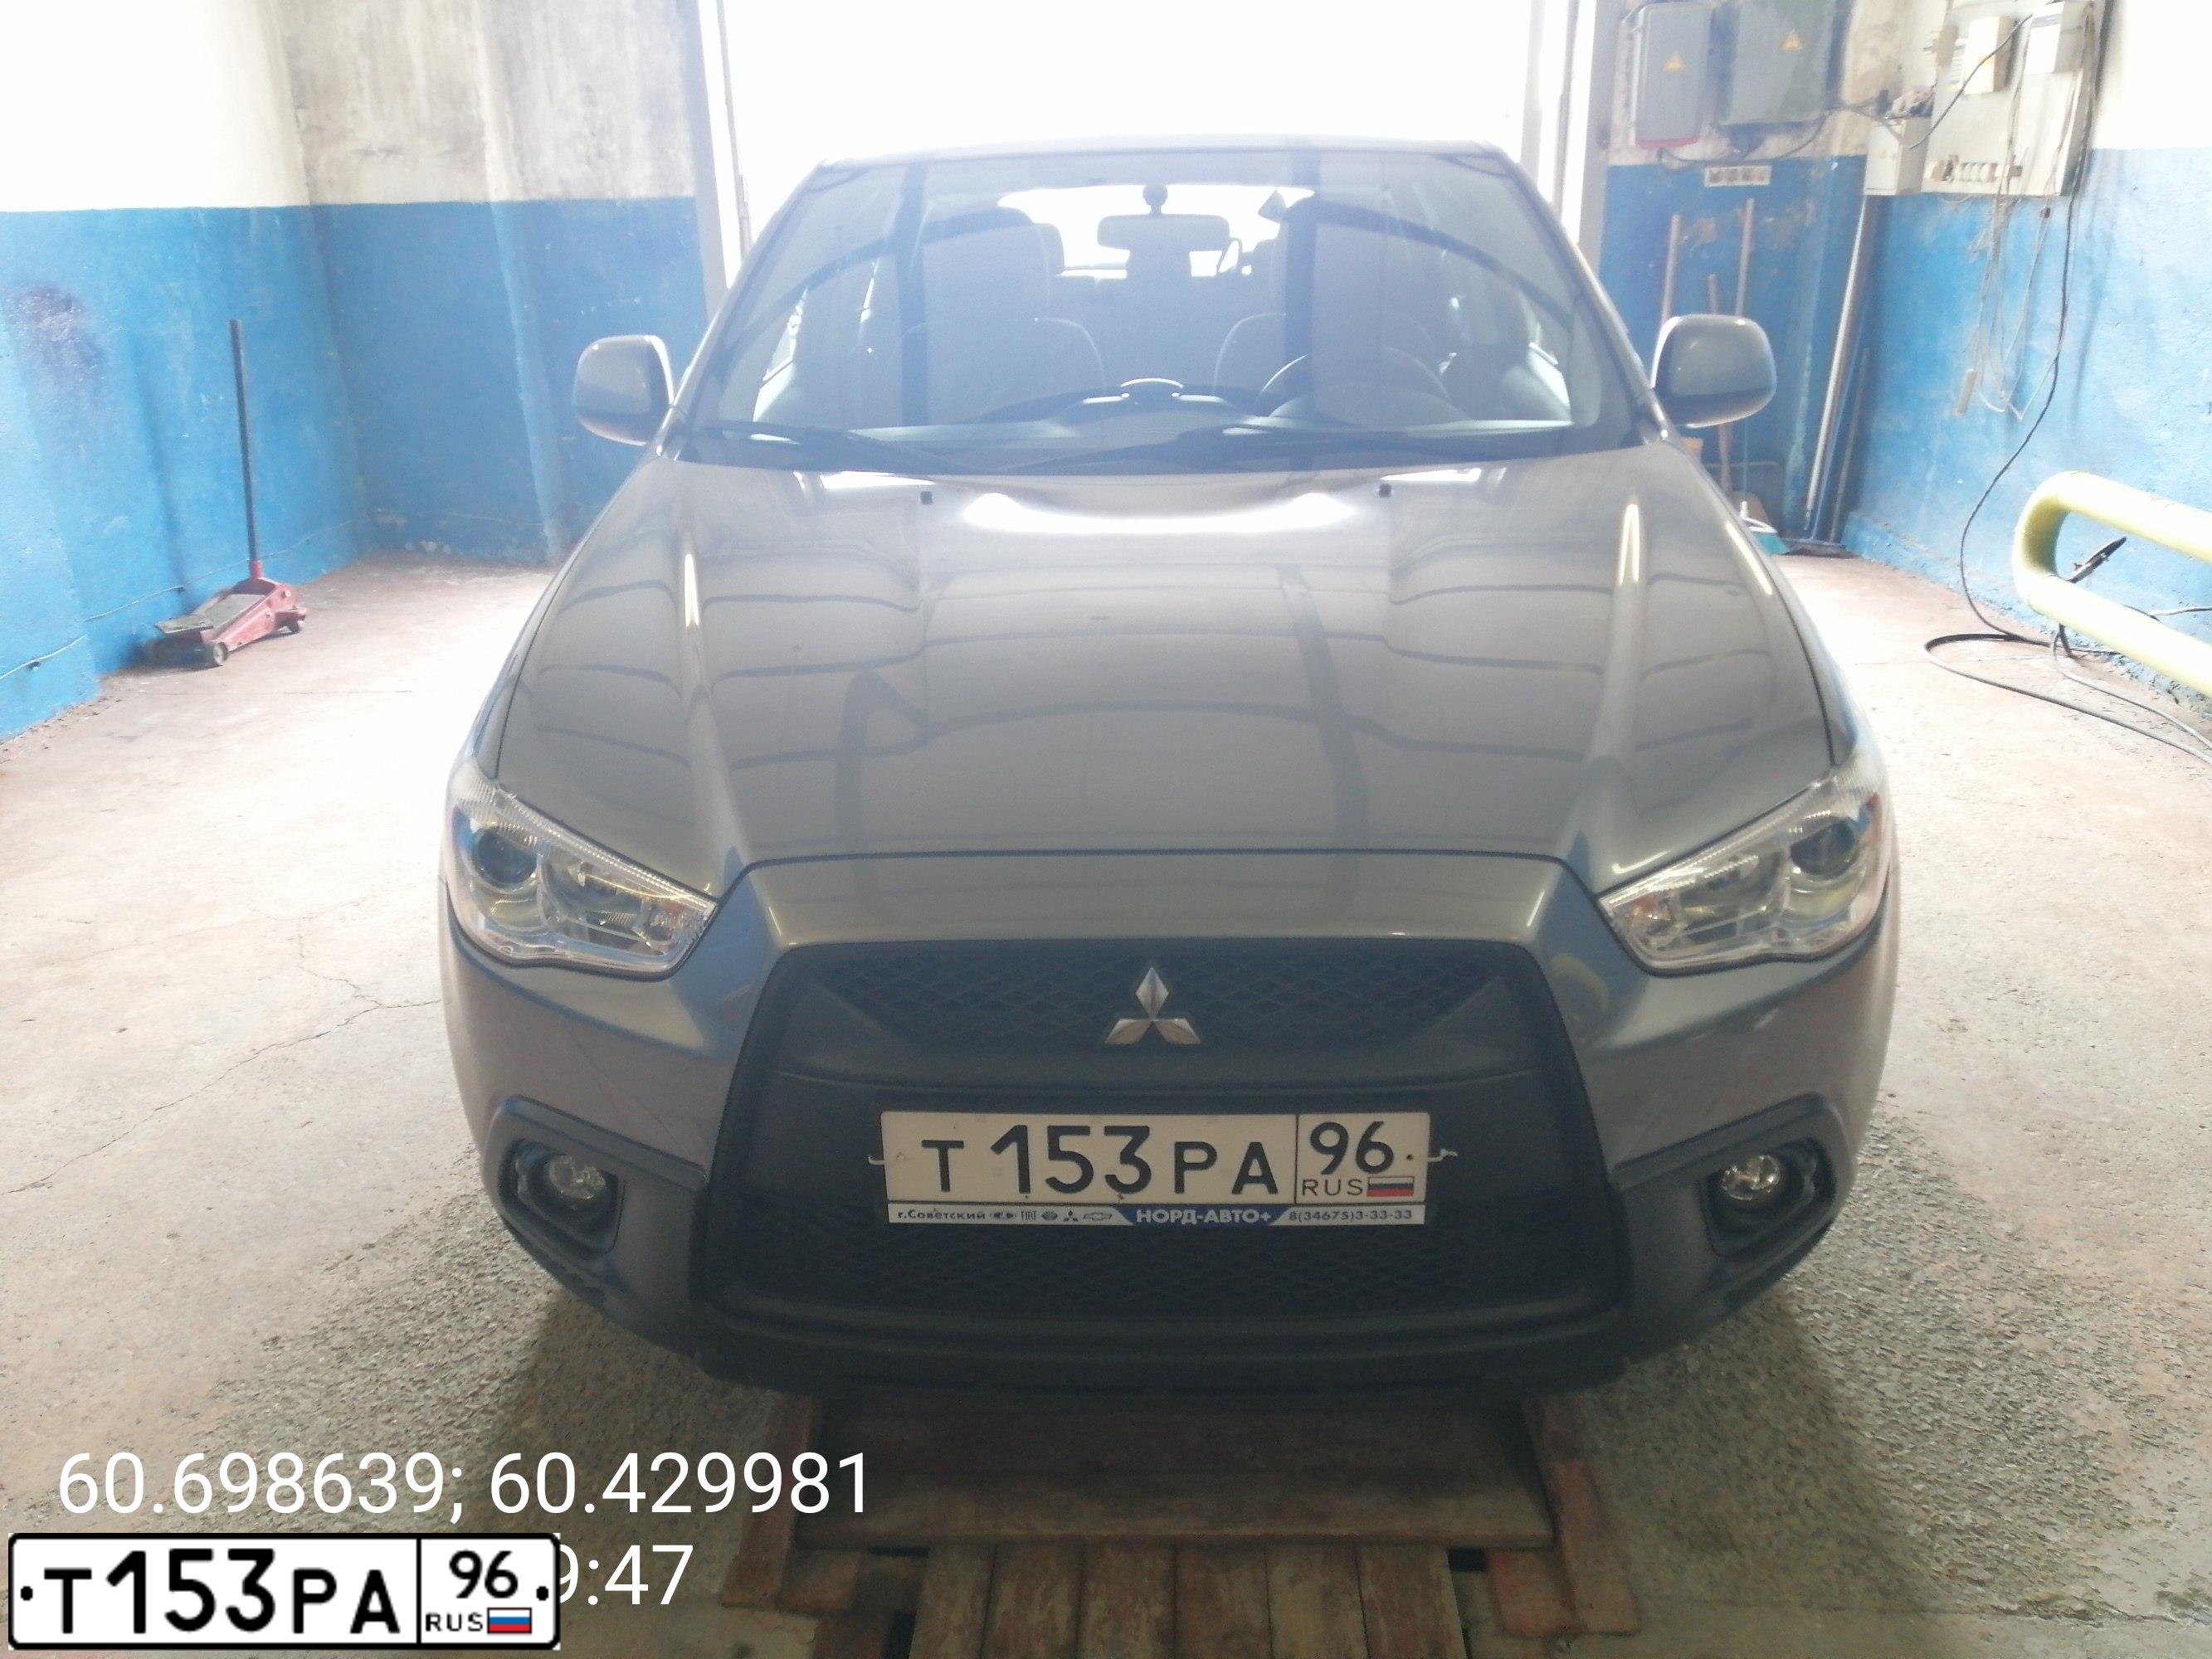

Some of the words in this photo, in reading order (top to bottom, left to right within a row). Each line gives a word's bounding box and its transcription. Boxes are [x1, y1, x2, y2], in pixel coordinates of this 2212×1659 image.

[1308, 1120, 1395, 1176] 96
[1301, 1177, 1364, 1197] RUS
[1136, 1208, 1272, 1225] НОРД-АВТО+
